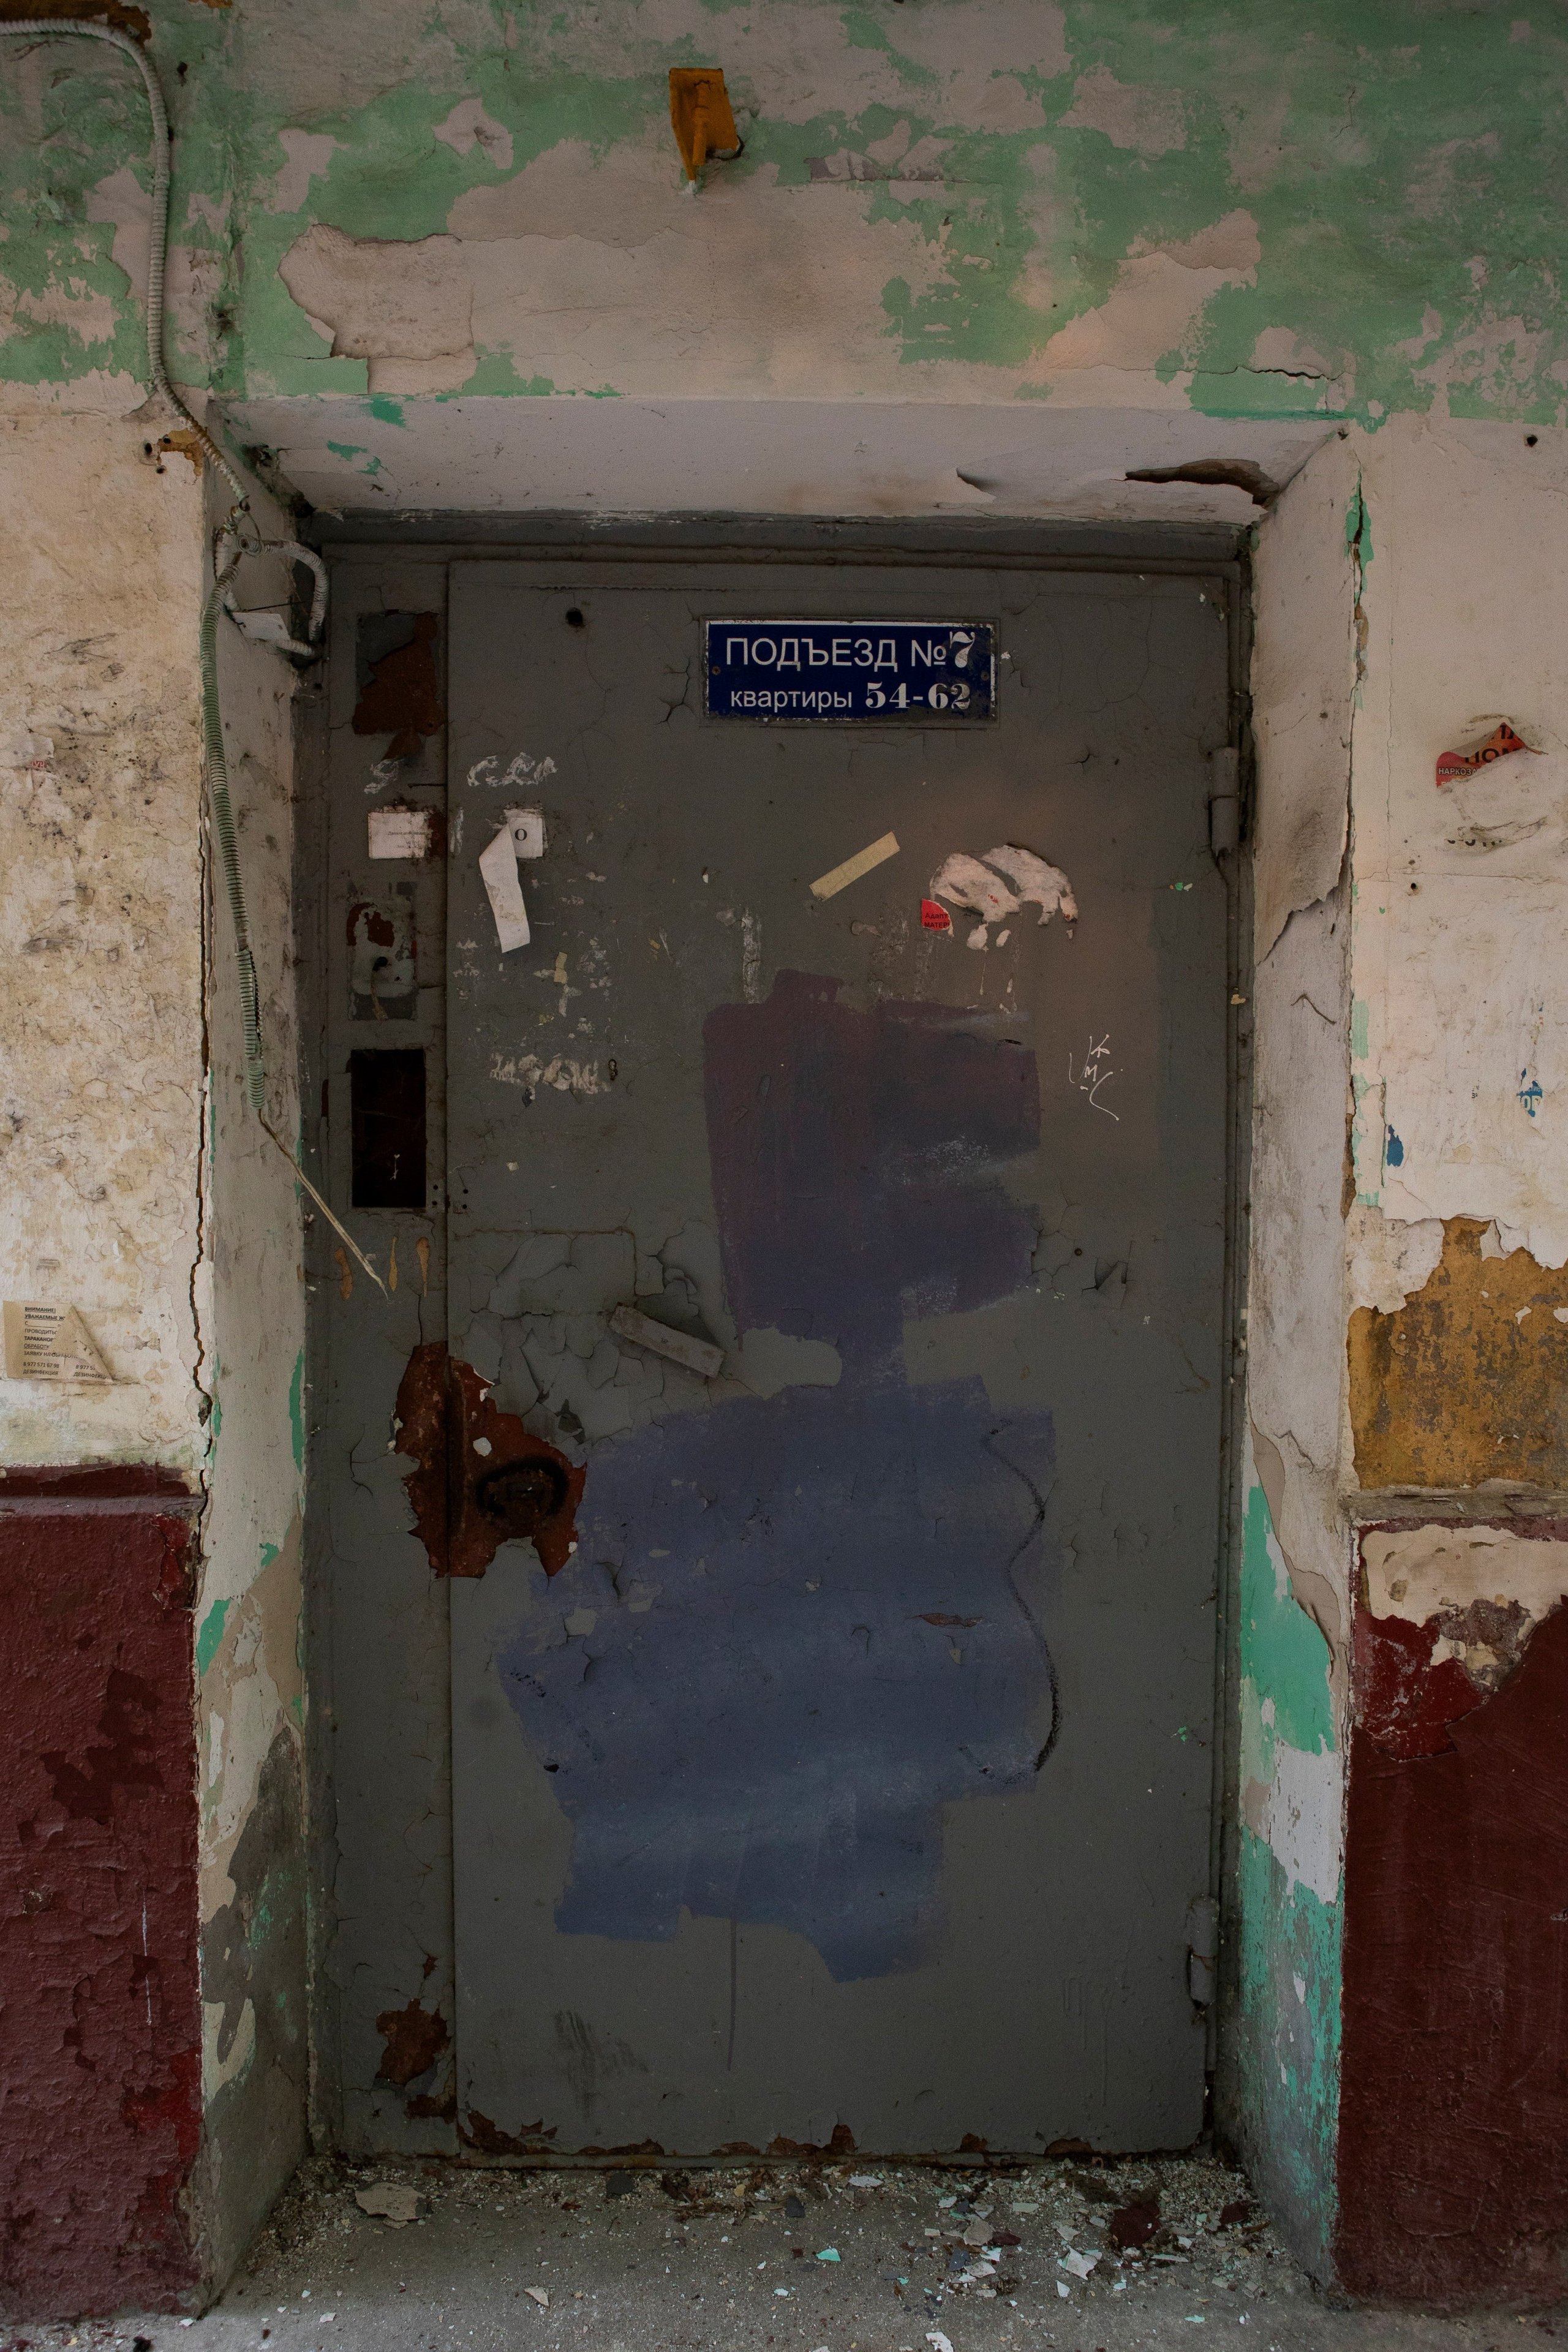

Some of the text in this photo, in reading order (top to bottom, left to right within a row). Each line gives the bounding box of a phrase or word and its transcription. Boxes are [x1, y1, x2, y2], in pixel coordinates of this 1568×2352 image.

[726, 637, 898, 672] ПОДЪЕЗД
[731, 682, 971, 713] квартиры 54-62
